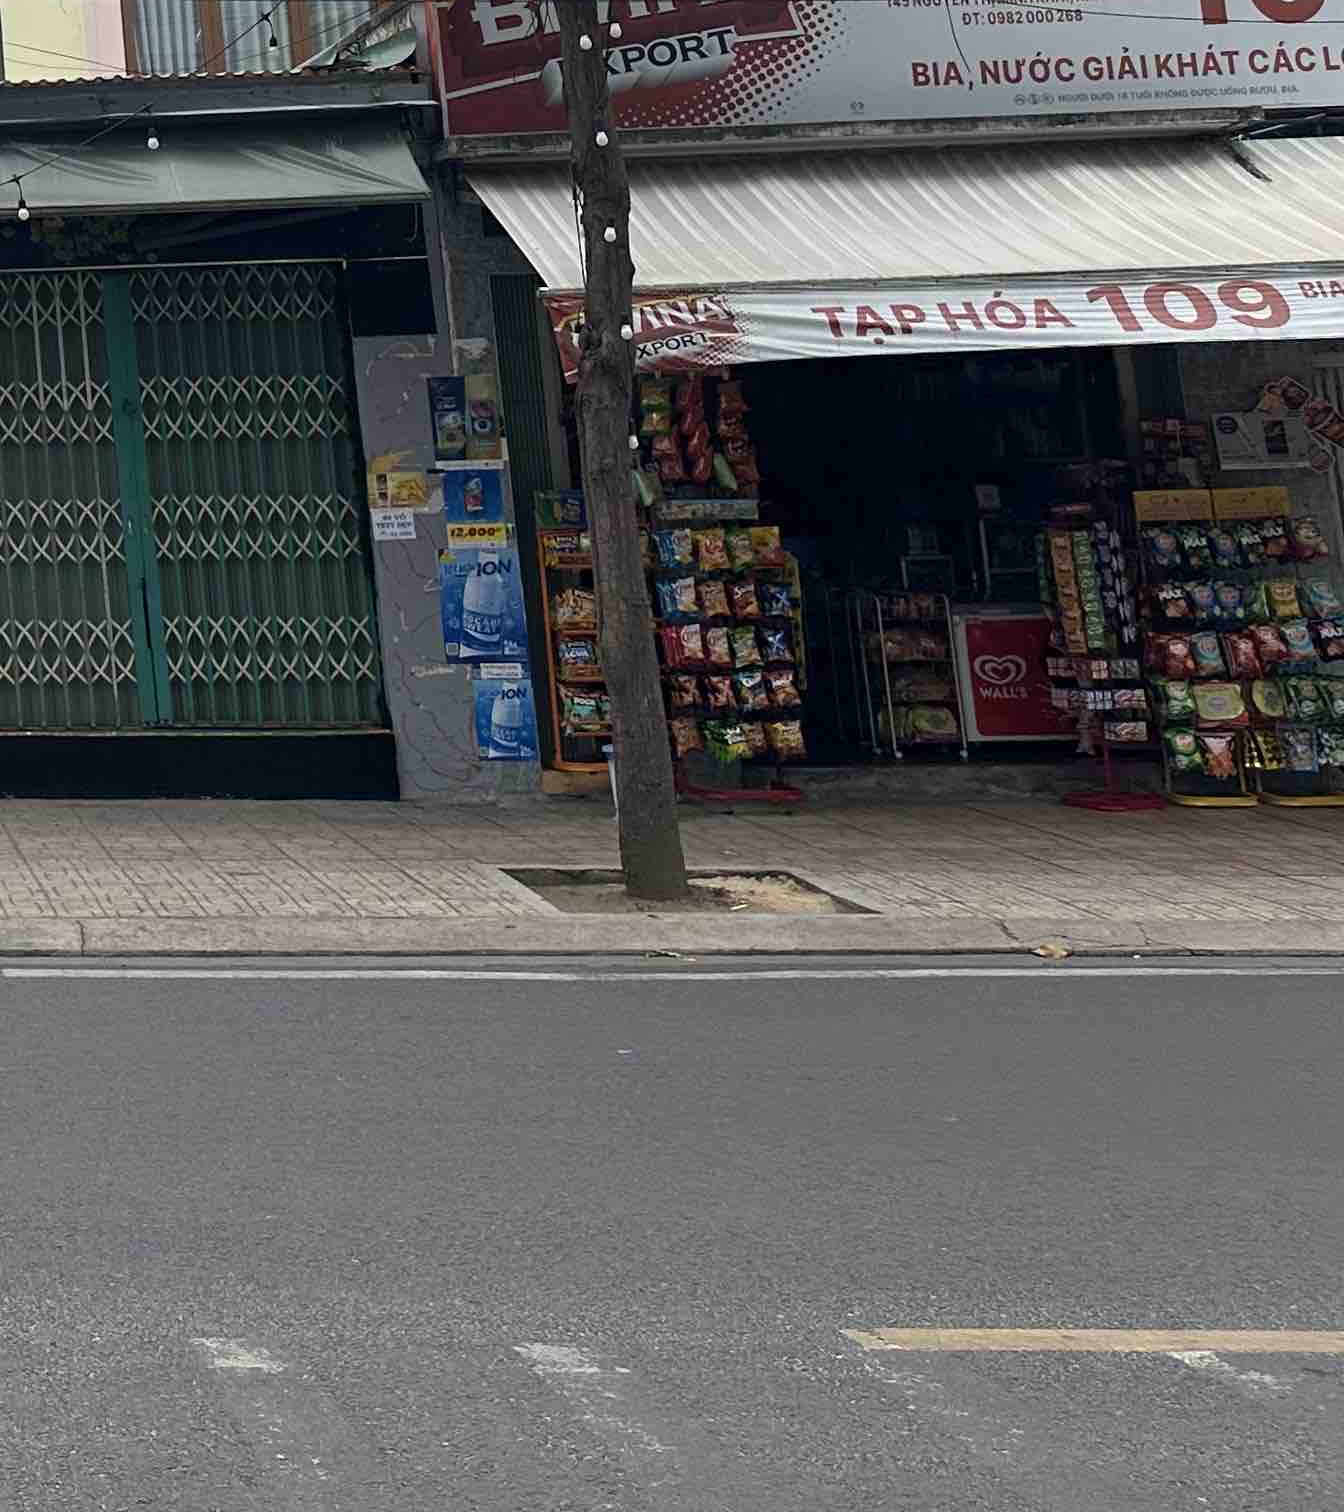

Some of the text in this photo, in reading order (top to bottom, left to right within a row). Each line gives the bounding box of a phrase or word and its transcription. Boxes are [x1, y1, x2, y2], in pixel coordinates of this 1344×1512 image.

[988, 9, 1023, 25] 0982
[1027, 9, 1054, 24] 000
[1057, 8, 1084, 22] 268
[560, 28, 735, 76] XPORT
[912, 60, 974, 90] BIA,
[981, 51, 1075, 85] NƯỚC
[1083, 46, 1148, 82] GIẢI
[1154, 41, 1239, 78] KHÁT
[1247, 41, 1316, 75] CÁC
[811, 304, 927, 346] TẠP
[937, 290, 1077, 333] HÓA
[1086, 279, 1292, 334] 109
[636, 332, 708, 361] XPORT
